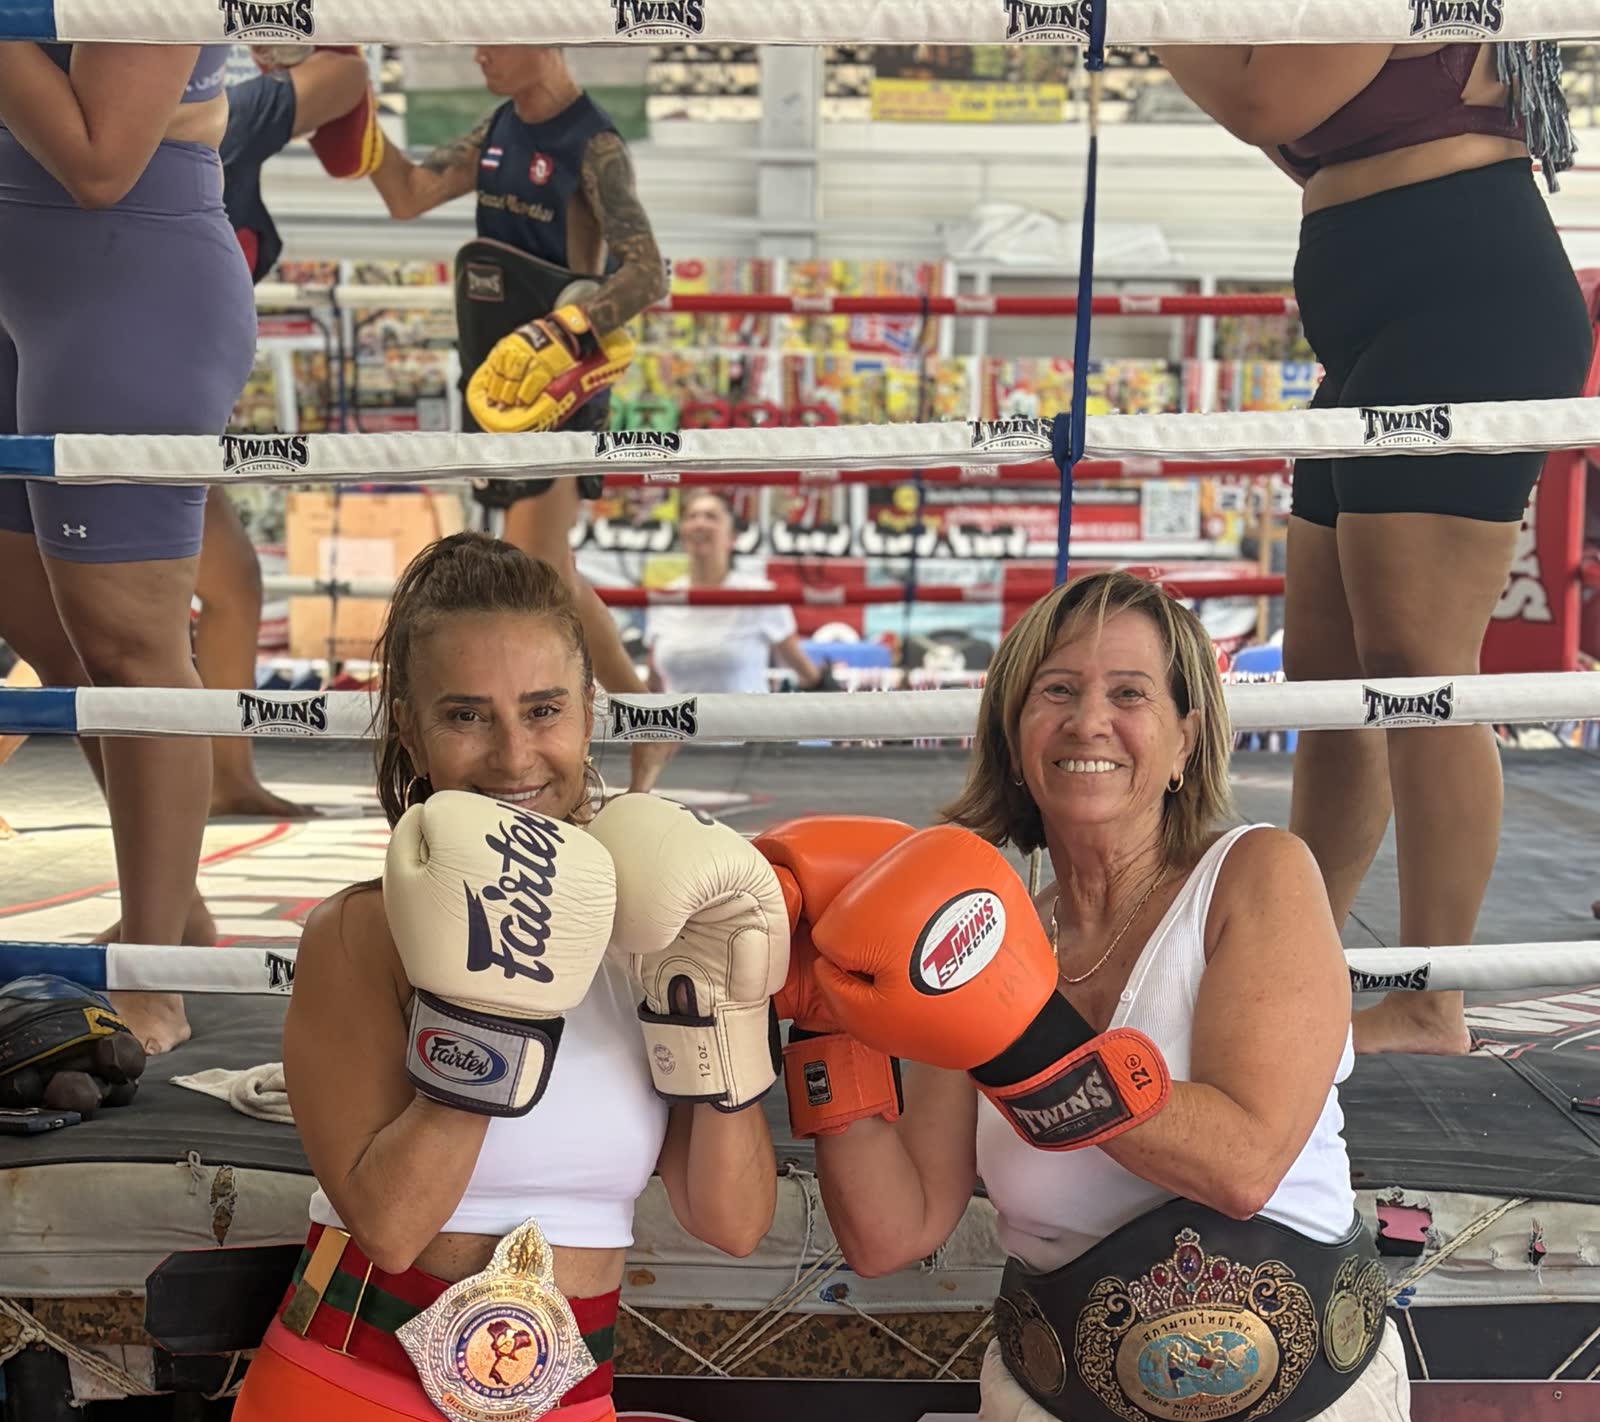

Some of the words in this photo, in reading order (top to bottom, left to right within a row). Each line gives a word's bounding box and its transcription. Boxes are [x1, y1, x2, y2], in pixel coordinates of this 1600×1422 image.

[219, 0, 315, 37] TWINS
[612, 0, 705, 34] TWINS
[1004, 0, 1092, 39] TWINS
[1408, 0, 1504, 36] TWINS
[1359, 404, 1452, 444] TWINS
[219, 435, 309, 471] TWINS
[592, 431, 682, 457] TWINS
[237, 691, 328, 732] TWINS
[608, 696, 698, 737] TWINS
[1362, 682, 1453, 725] TWINS
[463, 803, 565, 984] Fairtex
[922, 897, 995, 988] TWINS
[939, 916, 998, 986] SPECIAL
[428, 1037, 490, 1077] Fairtex
[698, 1062, 711, 1078] 12
[1130, 1067, 1153, 1091] 12
[1011, 1069, 1113, 1135] TWINS
[1172, 1404, 1239, 1420] CHAMPION
